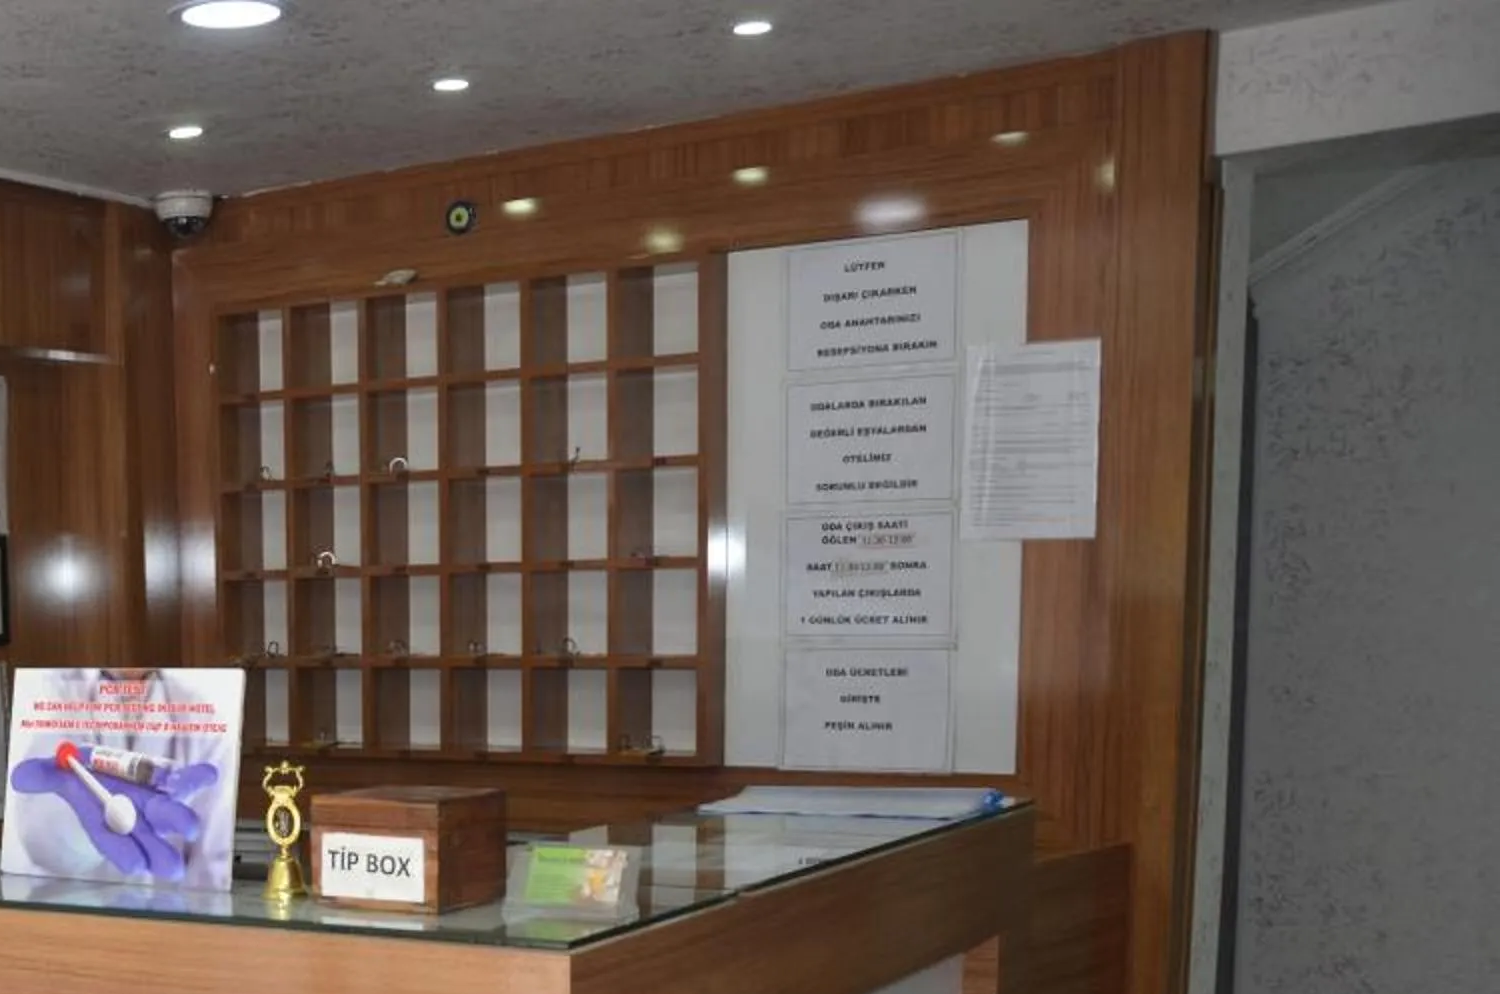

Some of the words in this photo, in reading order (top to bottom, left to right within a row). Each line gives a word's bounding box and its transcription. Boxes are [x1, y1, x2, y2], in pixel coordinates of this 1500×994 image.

[820, 320, 841, 330] ODA
[821, 522, 843, 532] ODA
[328, 846, 359, 871] TİP
[366, 853, 411, 877] BOX
